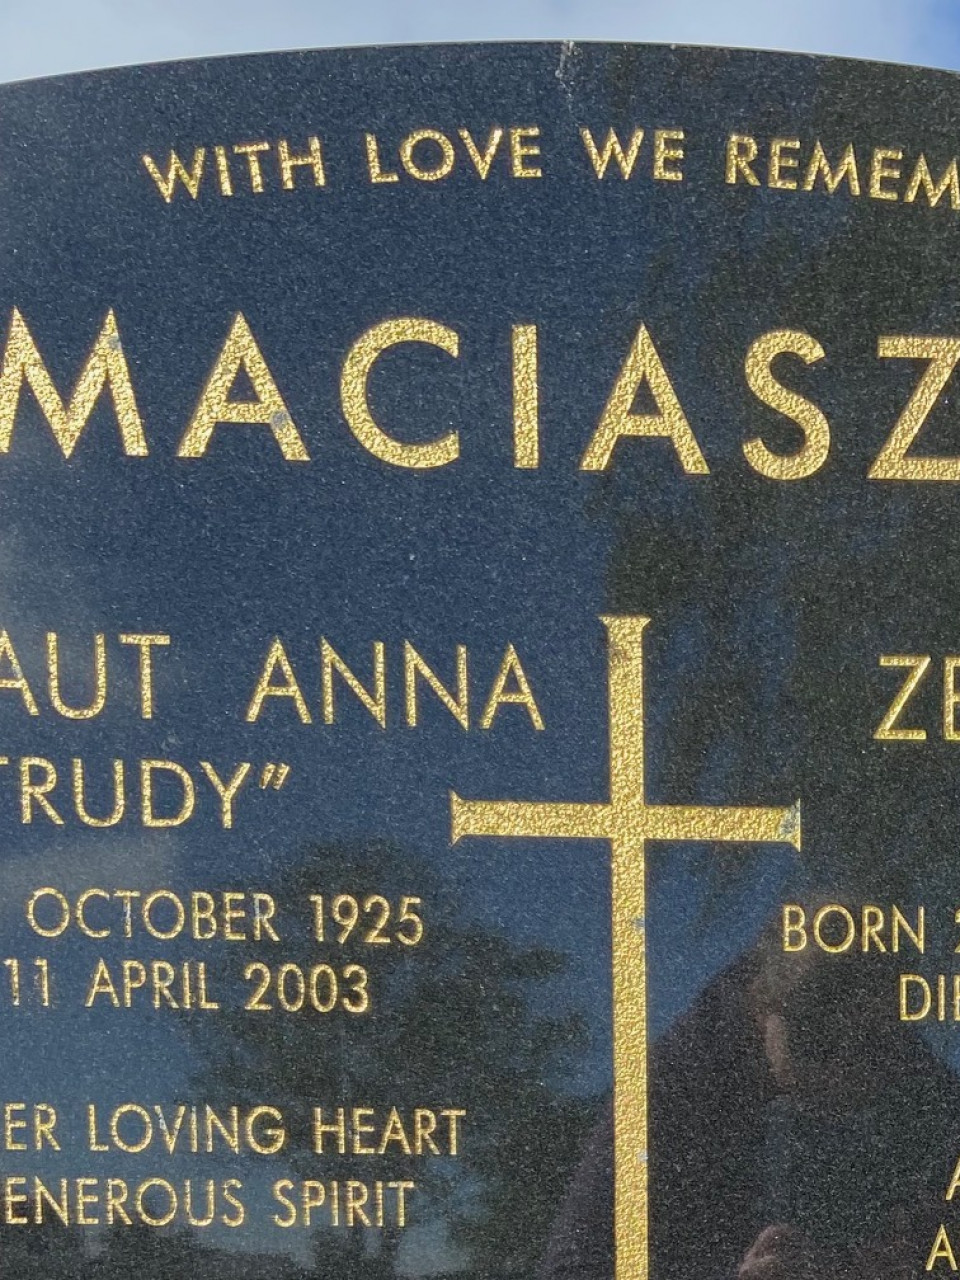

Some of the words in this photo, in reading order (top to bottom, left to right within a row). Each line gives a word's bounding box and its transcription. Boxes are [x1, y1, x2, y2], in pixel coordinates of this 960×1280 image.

[143, 139, 325, 200] WITH
[367, 128, 540, 182] LOVE
[584, 129, 683, 180] WE
[248, 642, 543, 729] ANNA
[0, 757, 289, 827] RUDY”
[27, 887, 277, 940] OCTOBER
[312, 894, 423, 945] 1925
[783, 904, 924, 953] BORN
[4, 957, 49, 1007] 11
[88, 960, 217, 1008] APRIL
[245, 963, 370, 1013] 2003
[89, 1105, 286, 1154] LOVING
[314, 1108, 466, 1154] HEART
[274, 1179, 413, 1226] SPIRIT
